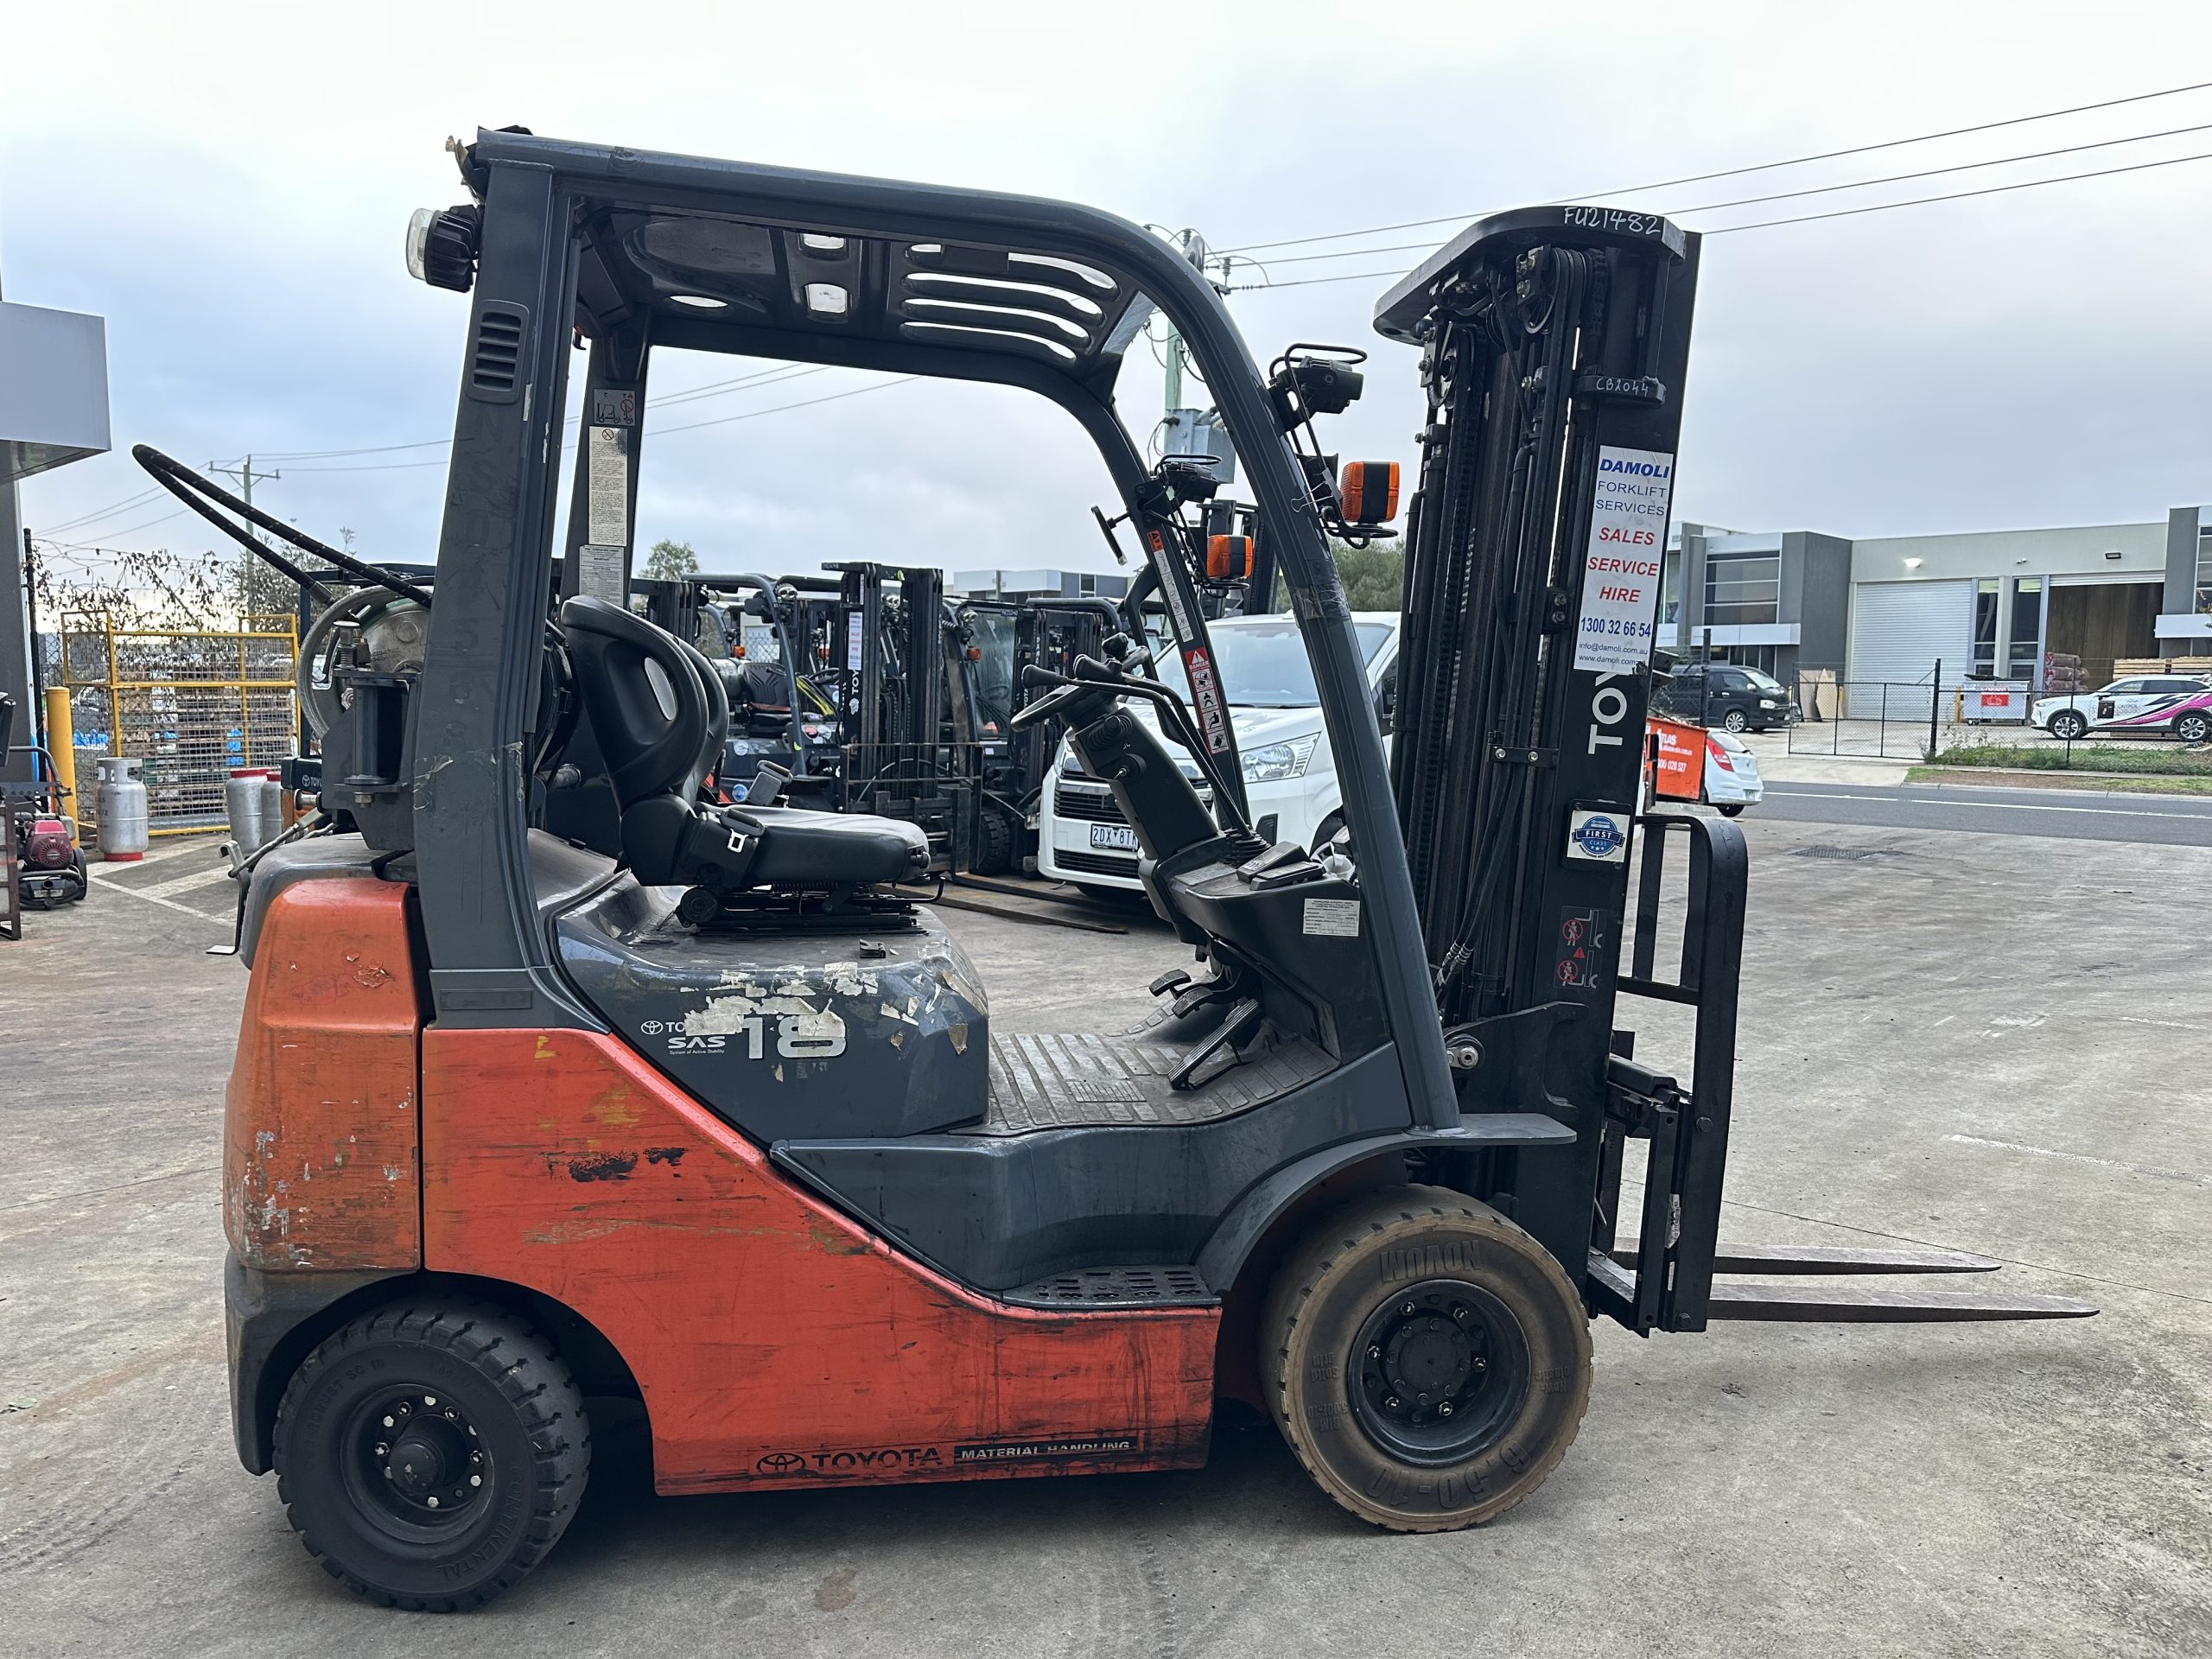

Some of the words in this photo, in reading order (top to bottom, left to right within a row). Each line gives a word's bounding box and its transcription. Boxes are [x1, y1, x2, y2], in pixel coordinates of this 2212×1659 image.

[1564, 206, 1661, 235] FU21482
[1599, 459, 1669, 479] DAMOLI
[1598, 480, 1667, 499] FORKLIFT
[1596, 499, 1665, 517] SERVICES
[1599, 527, 1655, 546] SALES
[1588, 556, 1659, 576] SERVICE
[1599, 587, 1641, 603] HIRE
[1581, 617, 1605, 633] 1300
[1608, 620, 1621, 635] 32
[1624, 621, 1637, 637] 66
[1638, 623, 1651, 638] 54
[1579, 641, 1648, 655] info@damoli.com.au
[1579, 655, 1645, 666] www.damoli.com
[1093, 828, 1111, 843] 2DX
[1586, 830, 1612, 839] FIRST
[668, 1036, 726, 1049] SAS
[741, 1014, 847, 1059] 18
[1378, 1239, 1482, 1283] NOVUM
[811, 1447, 944, 1468] TOYOTA
